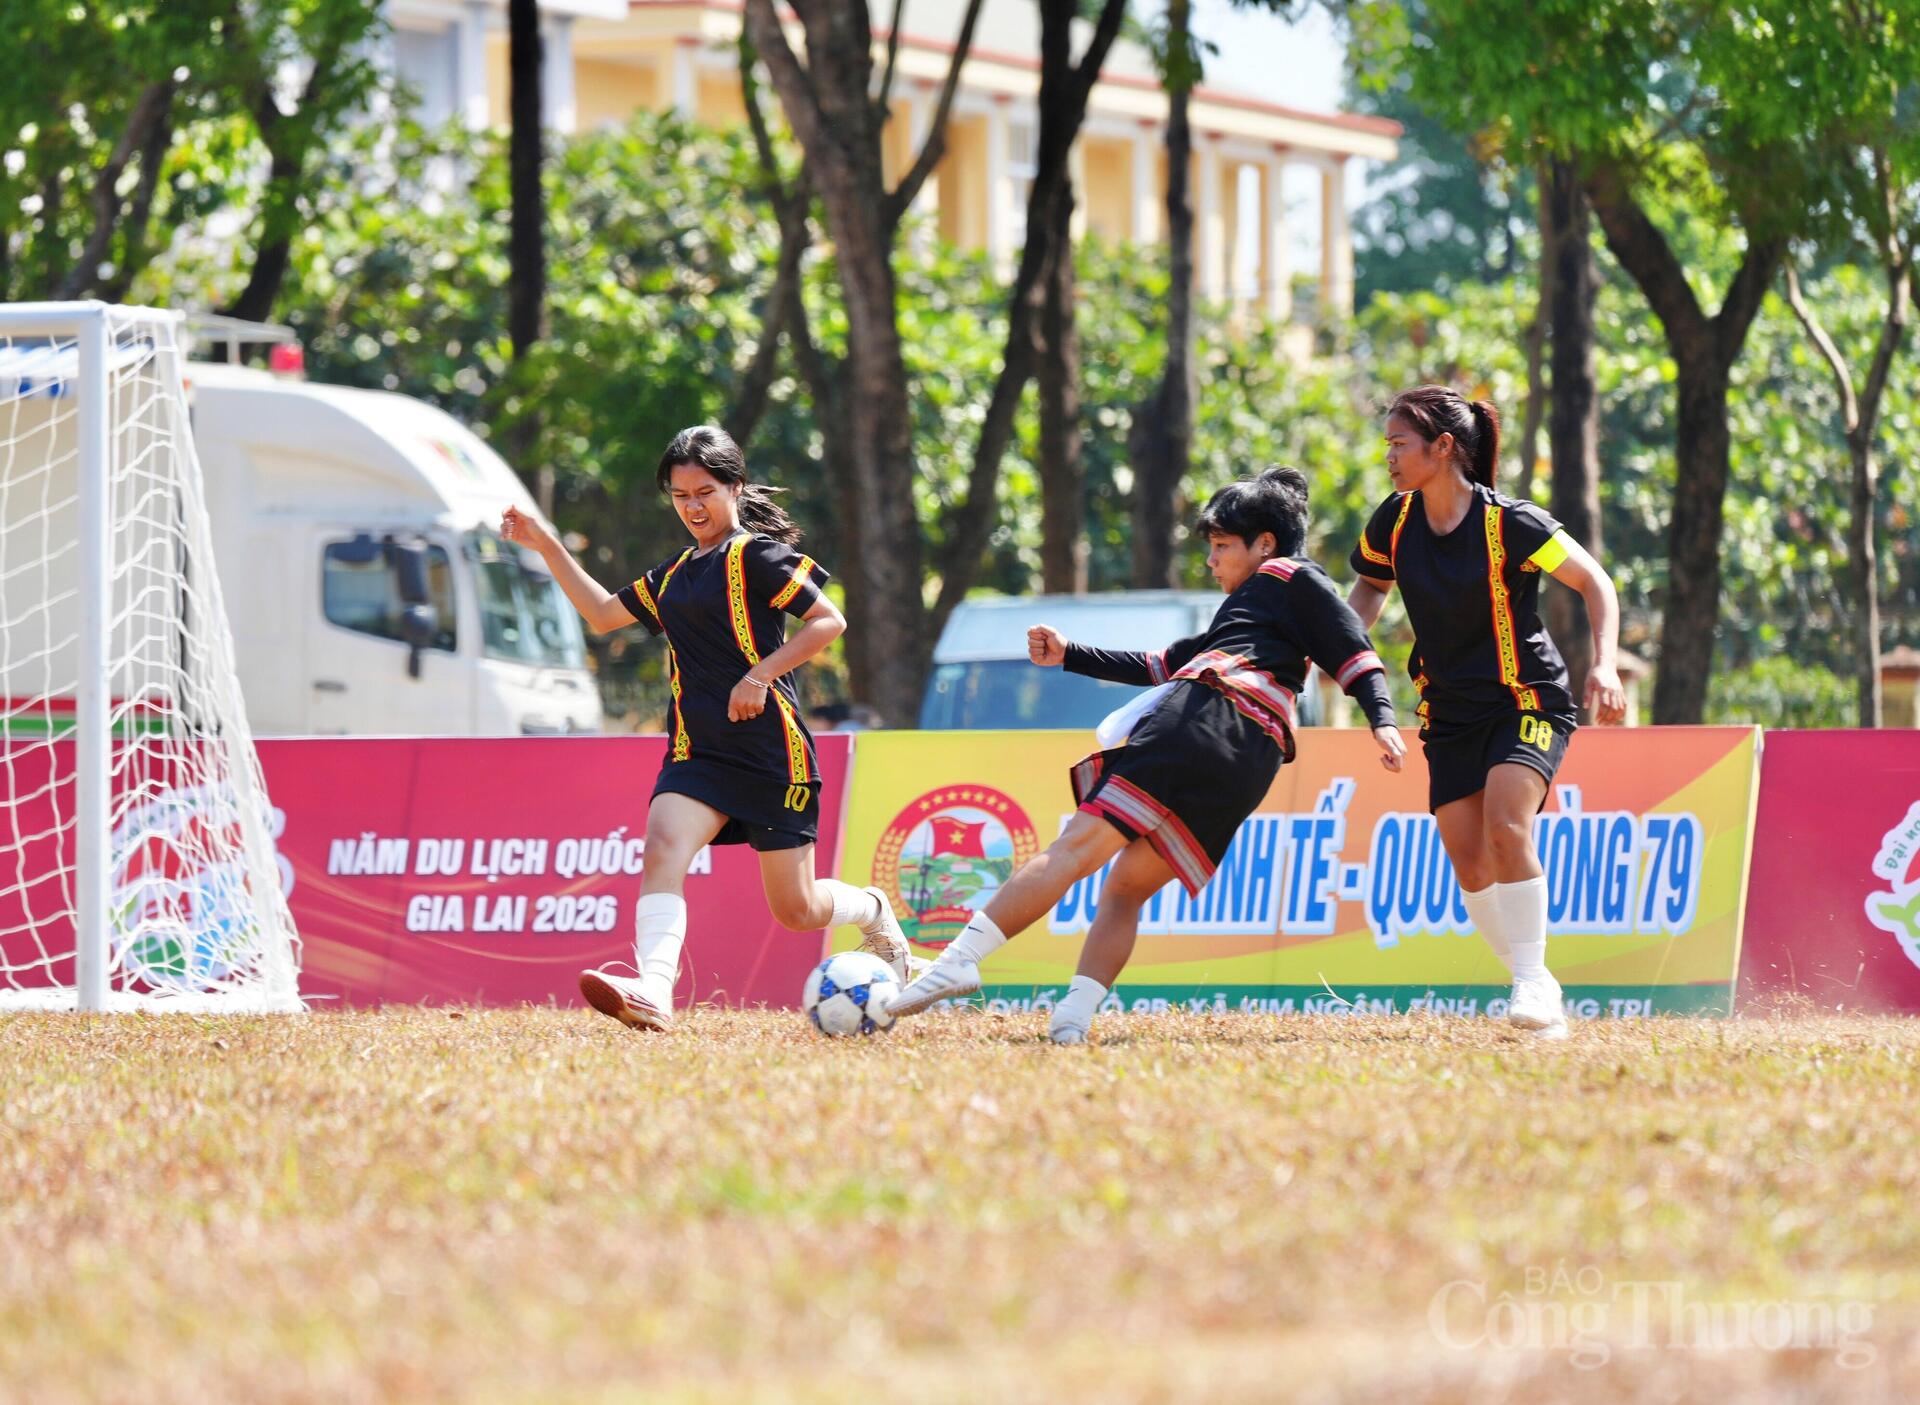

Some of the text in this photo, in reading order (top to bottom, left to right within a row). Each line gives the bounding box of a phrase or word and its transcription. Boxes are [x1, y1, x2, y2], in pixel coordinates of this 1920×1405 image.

[1519, 714, 1553, 752] 08
[783, 784, 811, 812] 10
[328, 832, 409, 876] NĂM
[415, 839, 466, 876] DU
[470, 839, 550, 883] LỊCH
[555, 826, 645, 877] QUỐC
[1285, 780, 1350, 927] TẾ
[1641, 815, 1698, 926] 79
[406, 895, 618, 932] GIA LAI 2026
